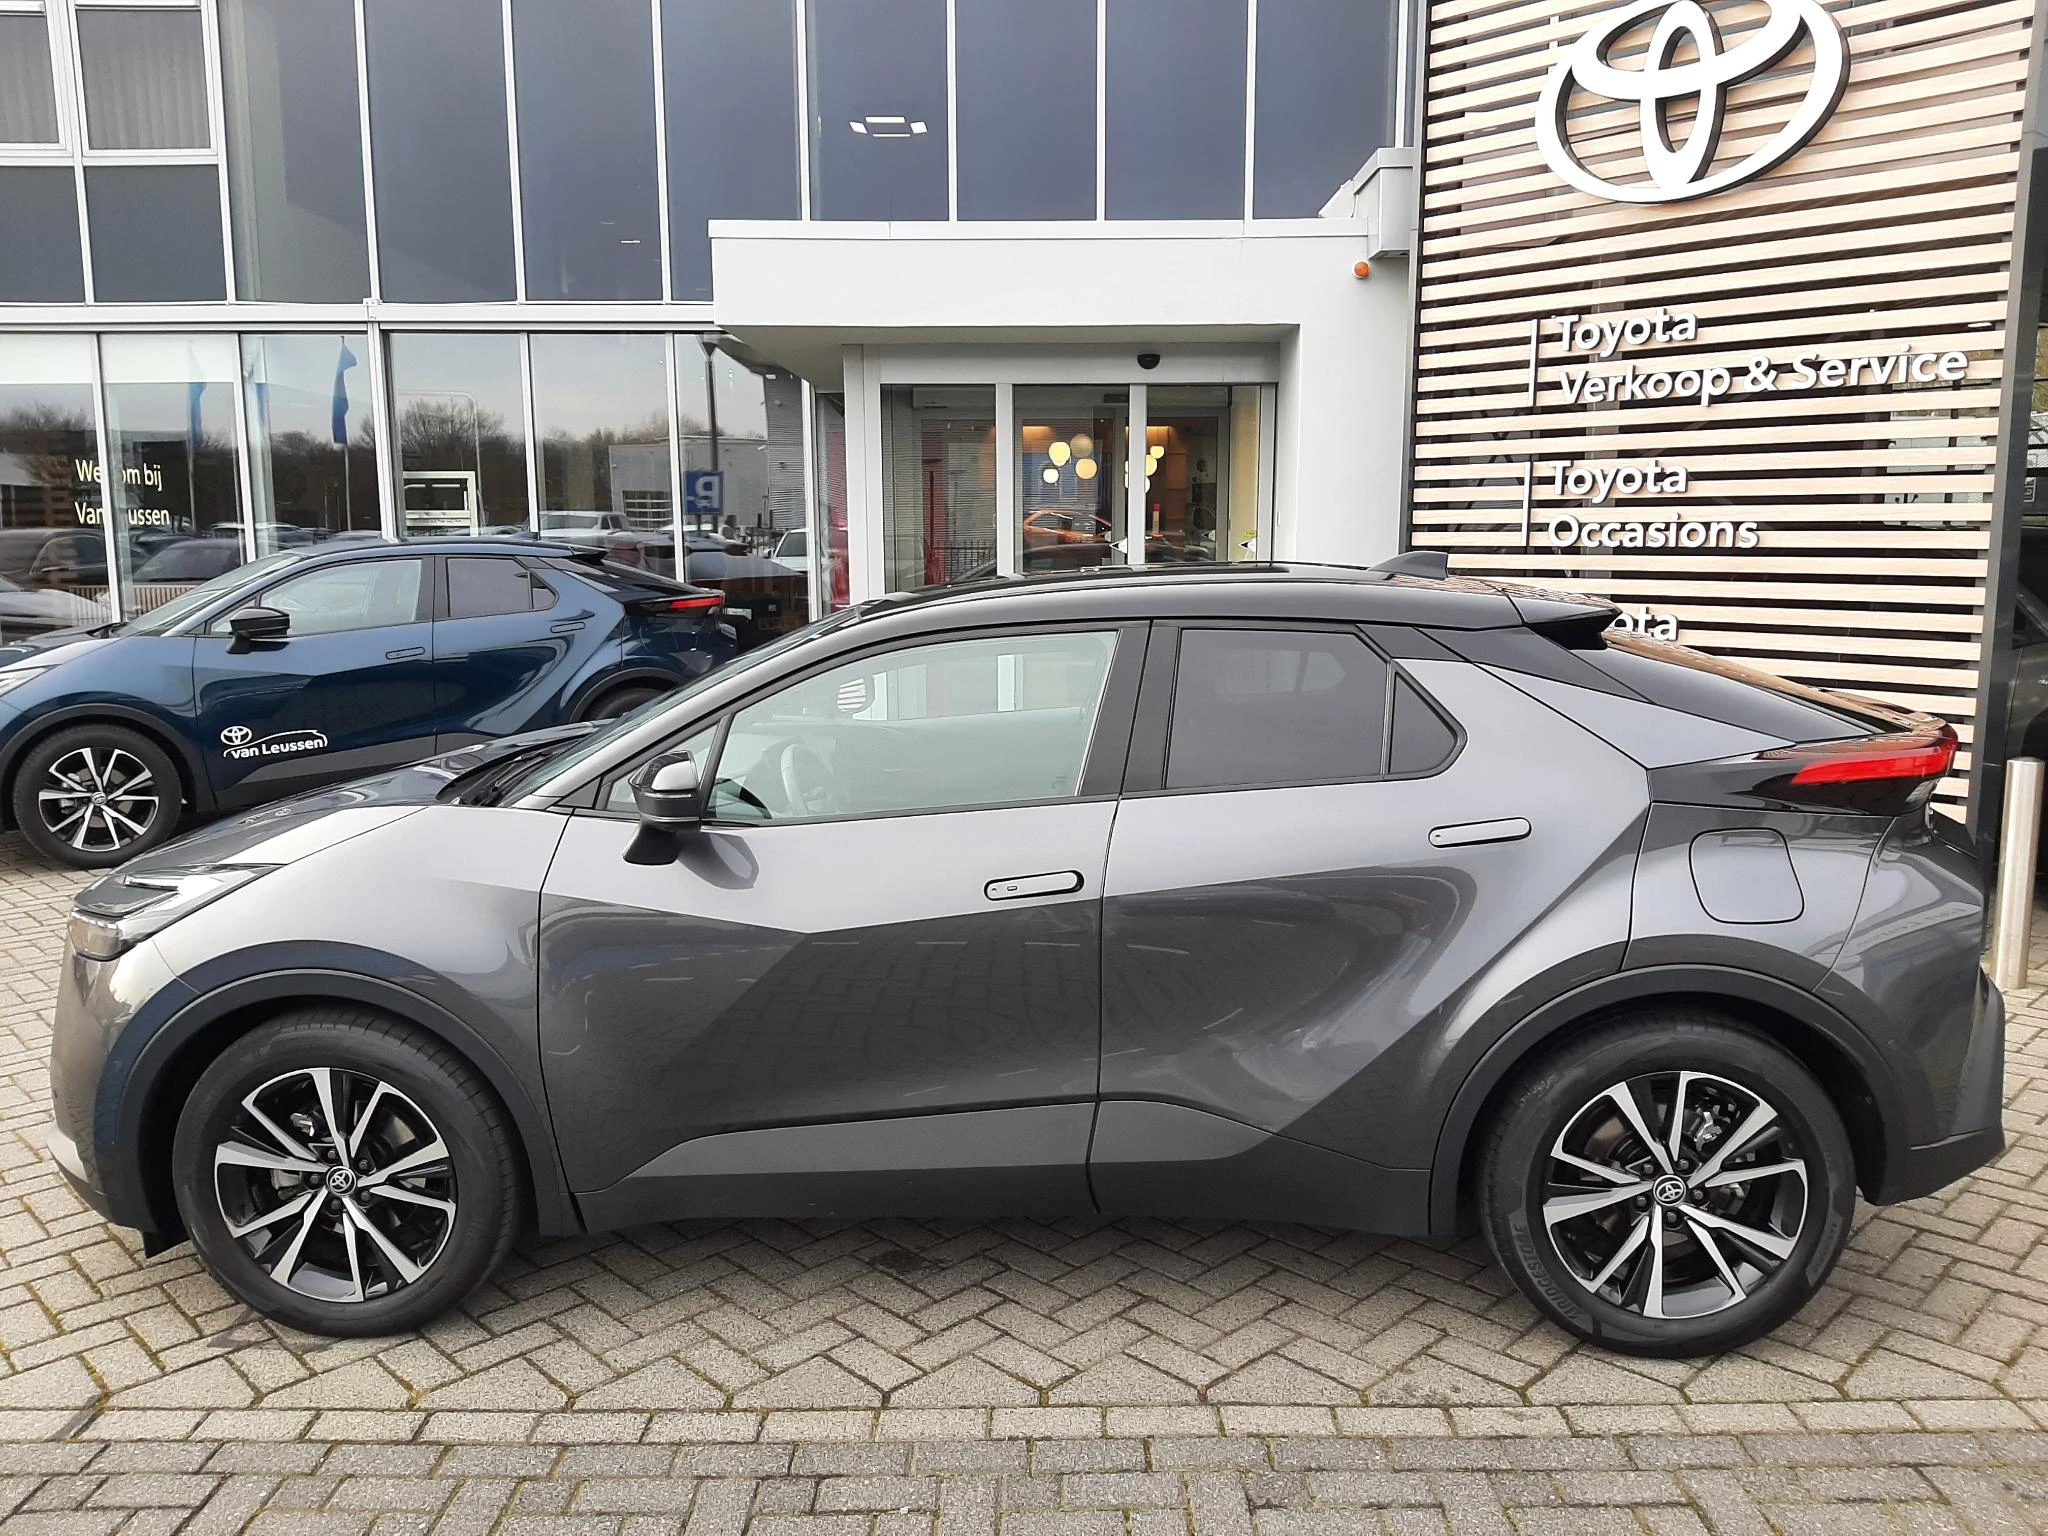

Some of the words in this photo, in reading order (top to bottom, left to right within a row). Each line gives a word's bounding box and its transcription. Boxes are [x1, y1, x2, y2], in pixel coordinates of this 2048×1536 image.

[1556, 308, 1697, 358] Toyota
[1560, 364, 1733, 407] Verkoop
[1744, 355, 1779, 392] &
[1792, 343, 1968, 390] Service
[75, 459, 140, 485] Wem
[143, 463, 162, 492] bij
[1549, 459, 1688, 503] Toyota
[75, 502, 105, 524] Van
[128, 508, 170, 526] ussen
[1548, 512, 1759, 548] Occasions
[1611, 606, 1679, 641] ota
[231, 747, 259, 759] van
[262, 738, 323, 755] Leussen
